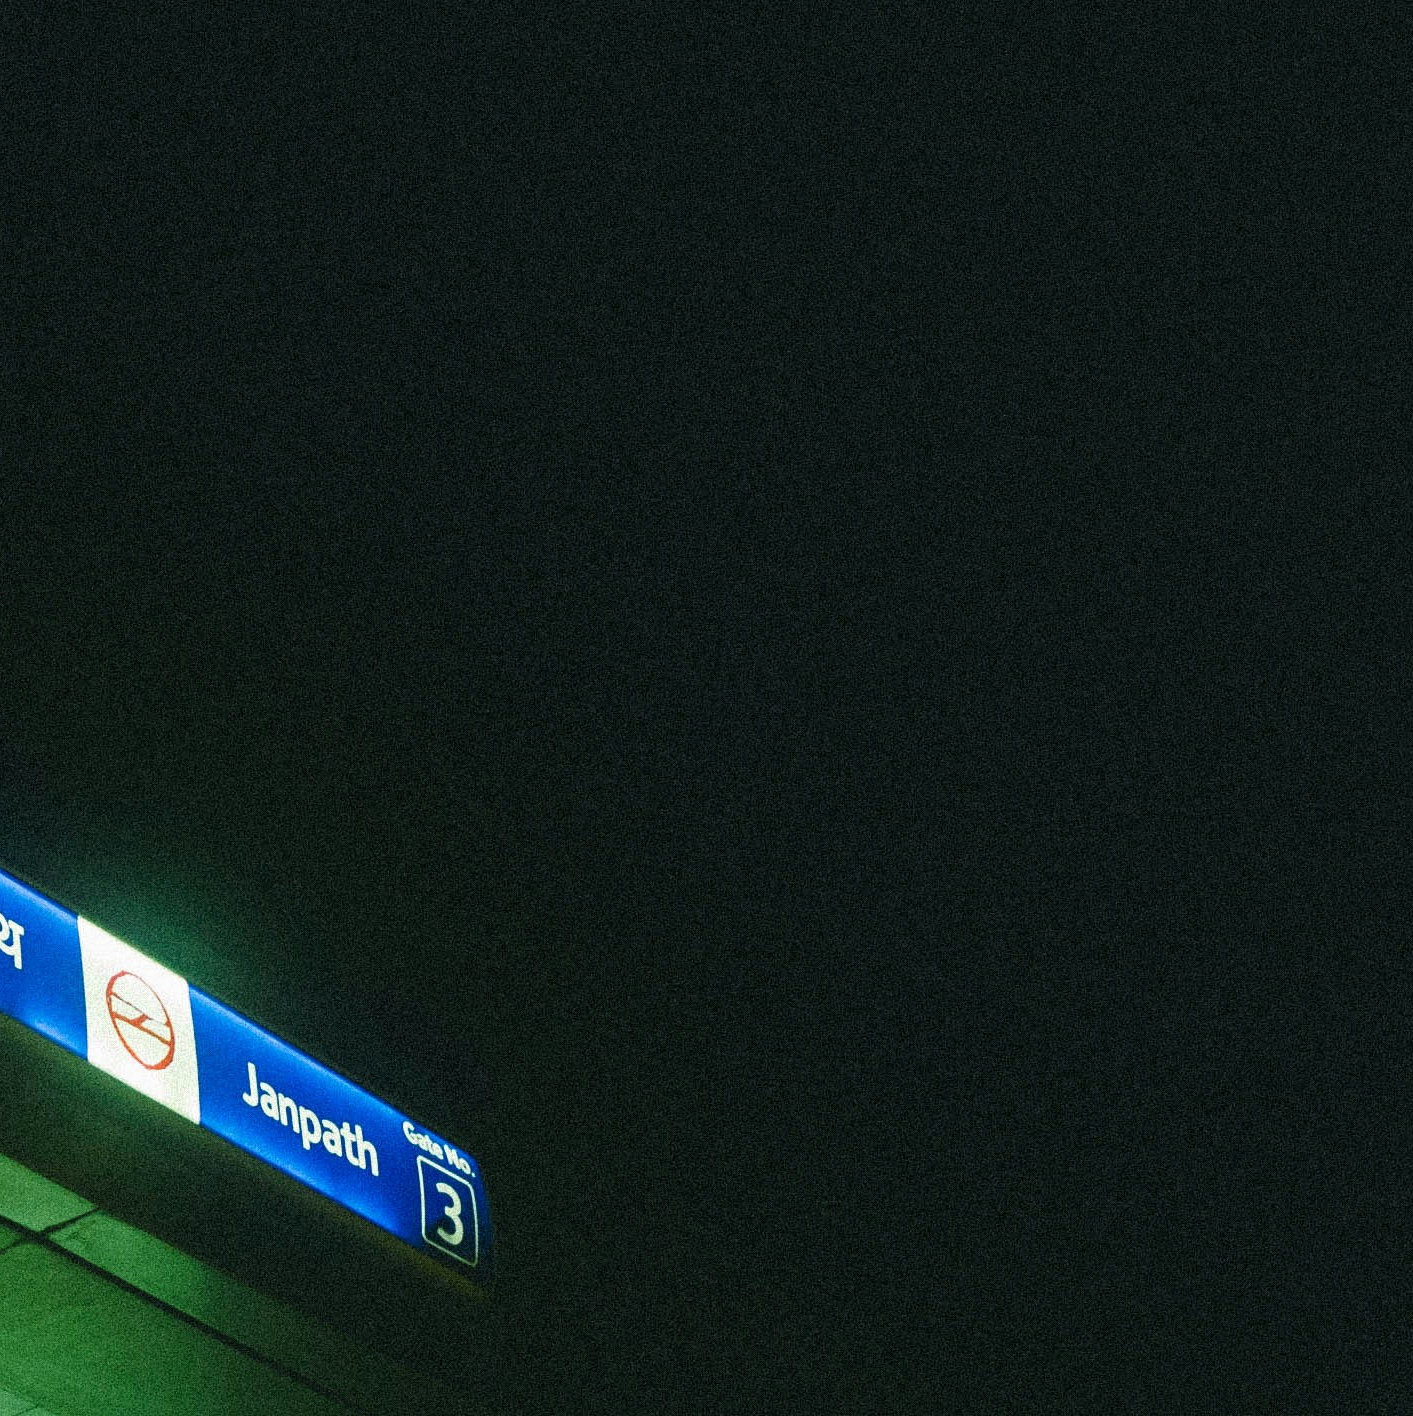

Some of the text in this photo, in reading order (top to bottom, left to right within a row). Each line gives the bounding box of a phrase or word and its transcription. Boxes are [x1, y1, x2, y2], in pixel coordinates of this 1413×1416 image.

[242, 1061, 380, 1177] Janpath
[402, 1120, 444, 1160] Gate
[435, 1182, 464, 1246] 3
